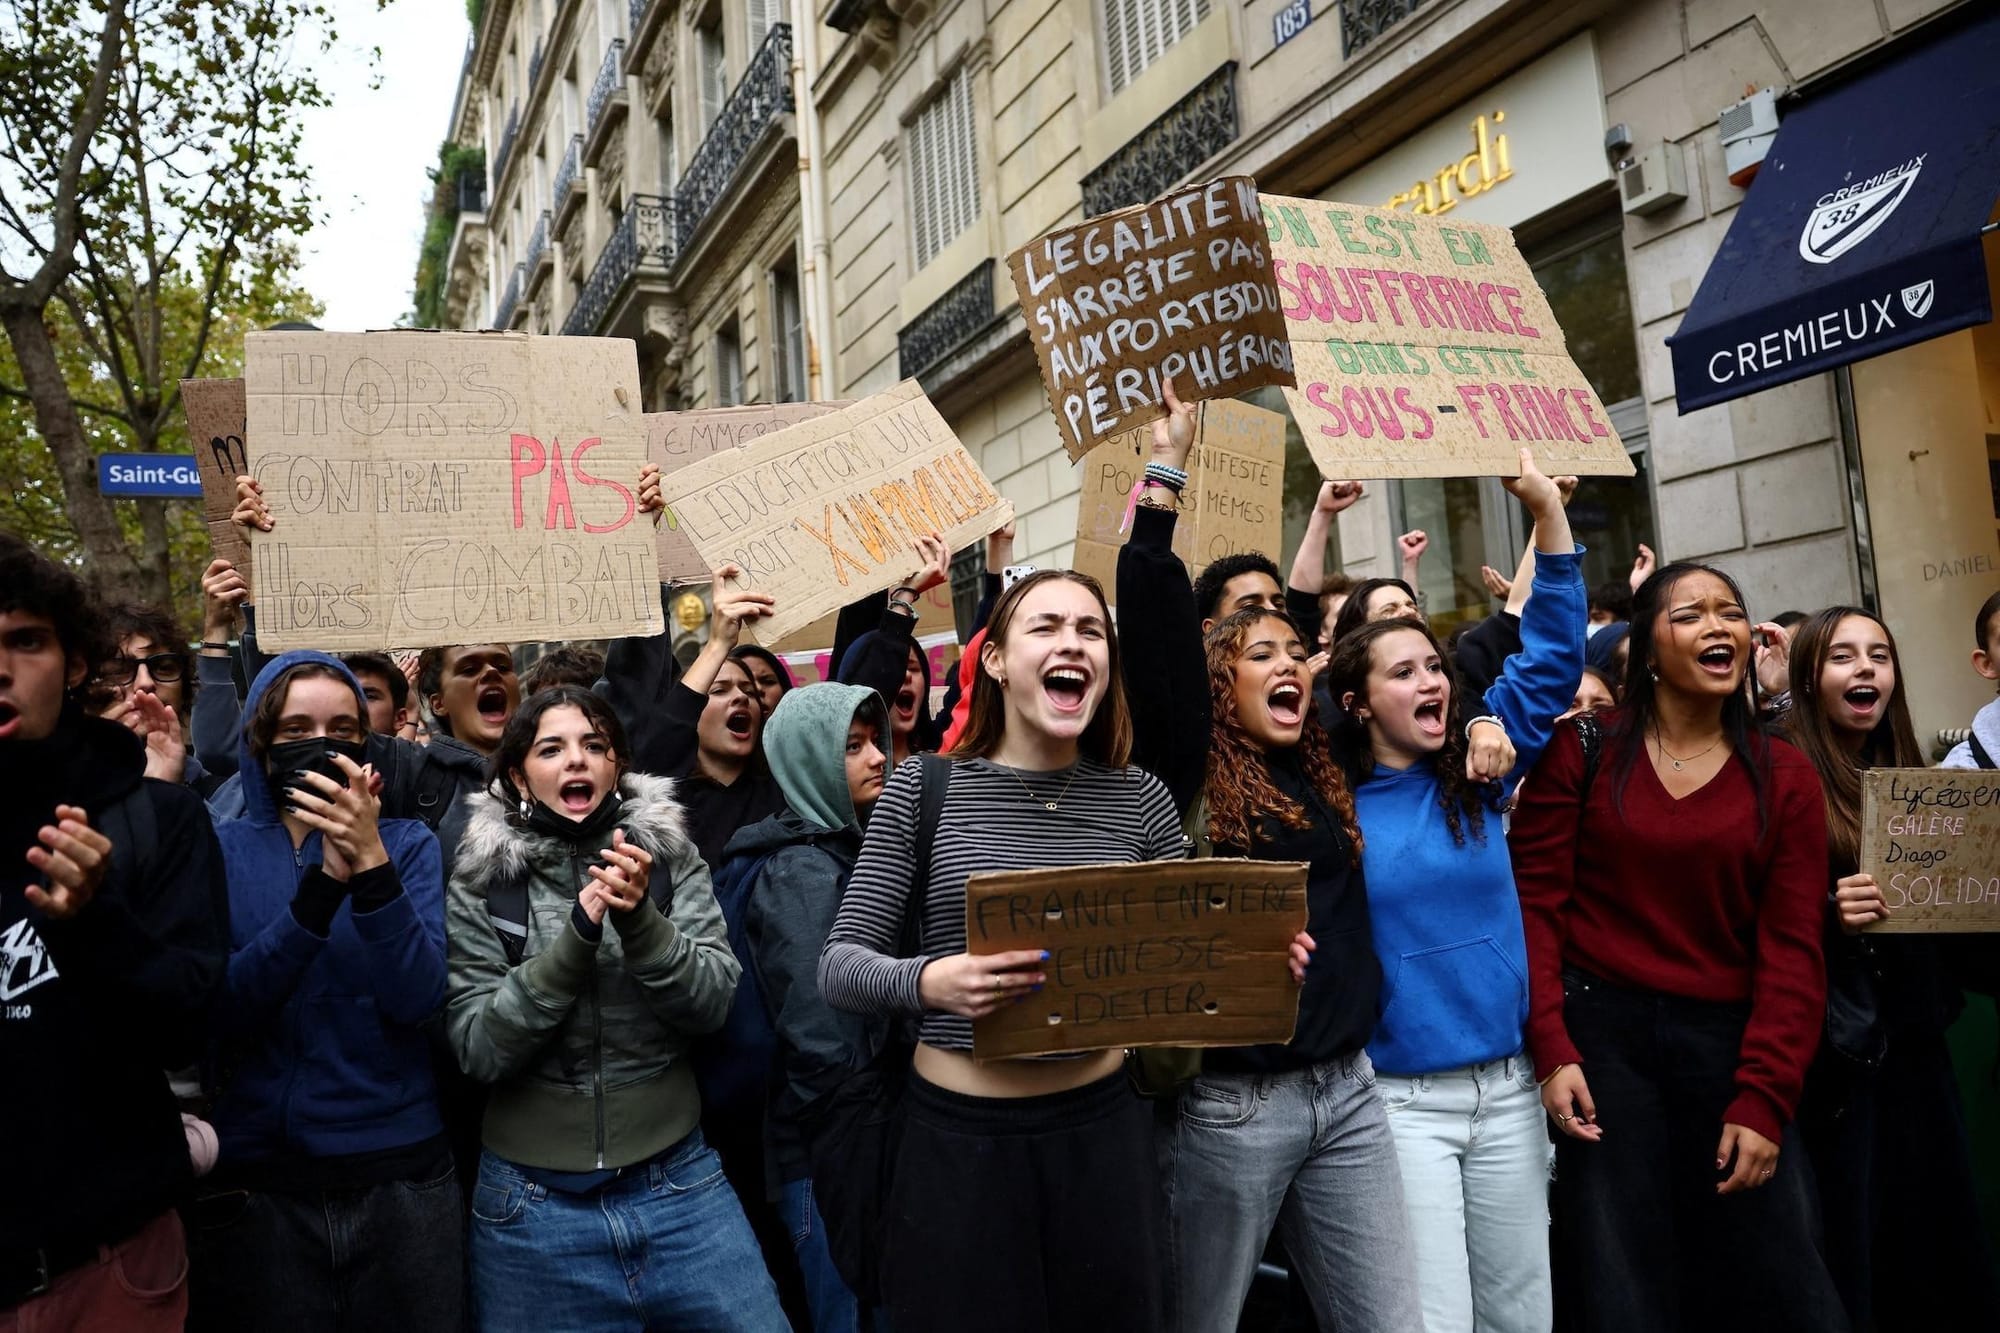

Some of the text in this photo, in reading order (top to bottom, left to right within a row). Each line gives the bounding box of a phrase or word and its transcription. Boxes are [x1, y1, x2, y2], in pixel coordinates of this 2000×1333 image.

[1275, 0, 1308, 45] 185
[1816, 152, 1928, 208] CREMIEUX
[1326, 210, 1422, 261] EST
[1438, 227, 1494, 266] EN
[1822, 203, 1860, 230] 38
[1036, 237, 1265, 345] S'ARRÊTE PAS
[1274, 260, 1541, 339] SOUFFRANCE
[1050, 331, 1109, 390] AUX
[1325, 338, 1537, 378] DANS CETTE
[1708, 289, 1920, 384] CREMIEUX 38
[281, 352, 519, 437] HORS
[875, 404, 933, 455] UN
[255, 452, 469, 515] CONTRAT
[510, 434, 636, 534] PAS
[1186, 445, 1273, 487] ANIFESTÉ
[1207, 489, 1265, 524] MÊMES
[258, 538, 652, 634] HORS COMBAT
[1923, 554, 2000, 582] DANIEL
[1888, 811, 1965, 836] GALÈRE
[1885, 841, 1947, 869] Diago
[976, 887, 1138, 942] FRANCE
[1055, 932, 1228, 988] EUNESSE
